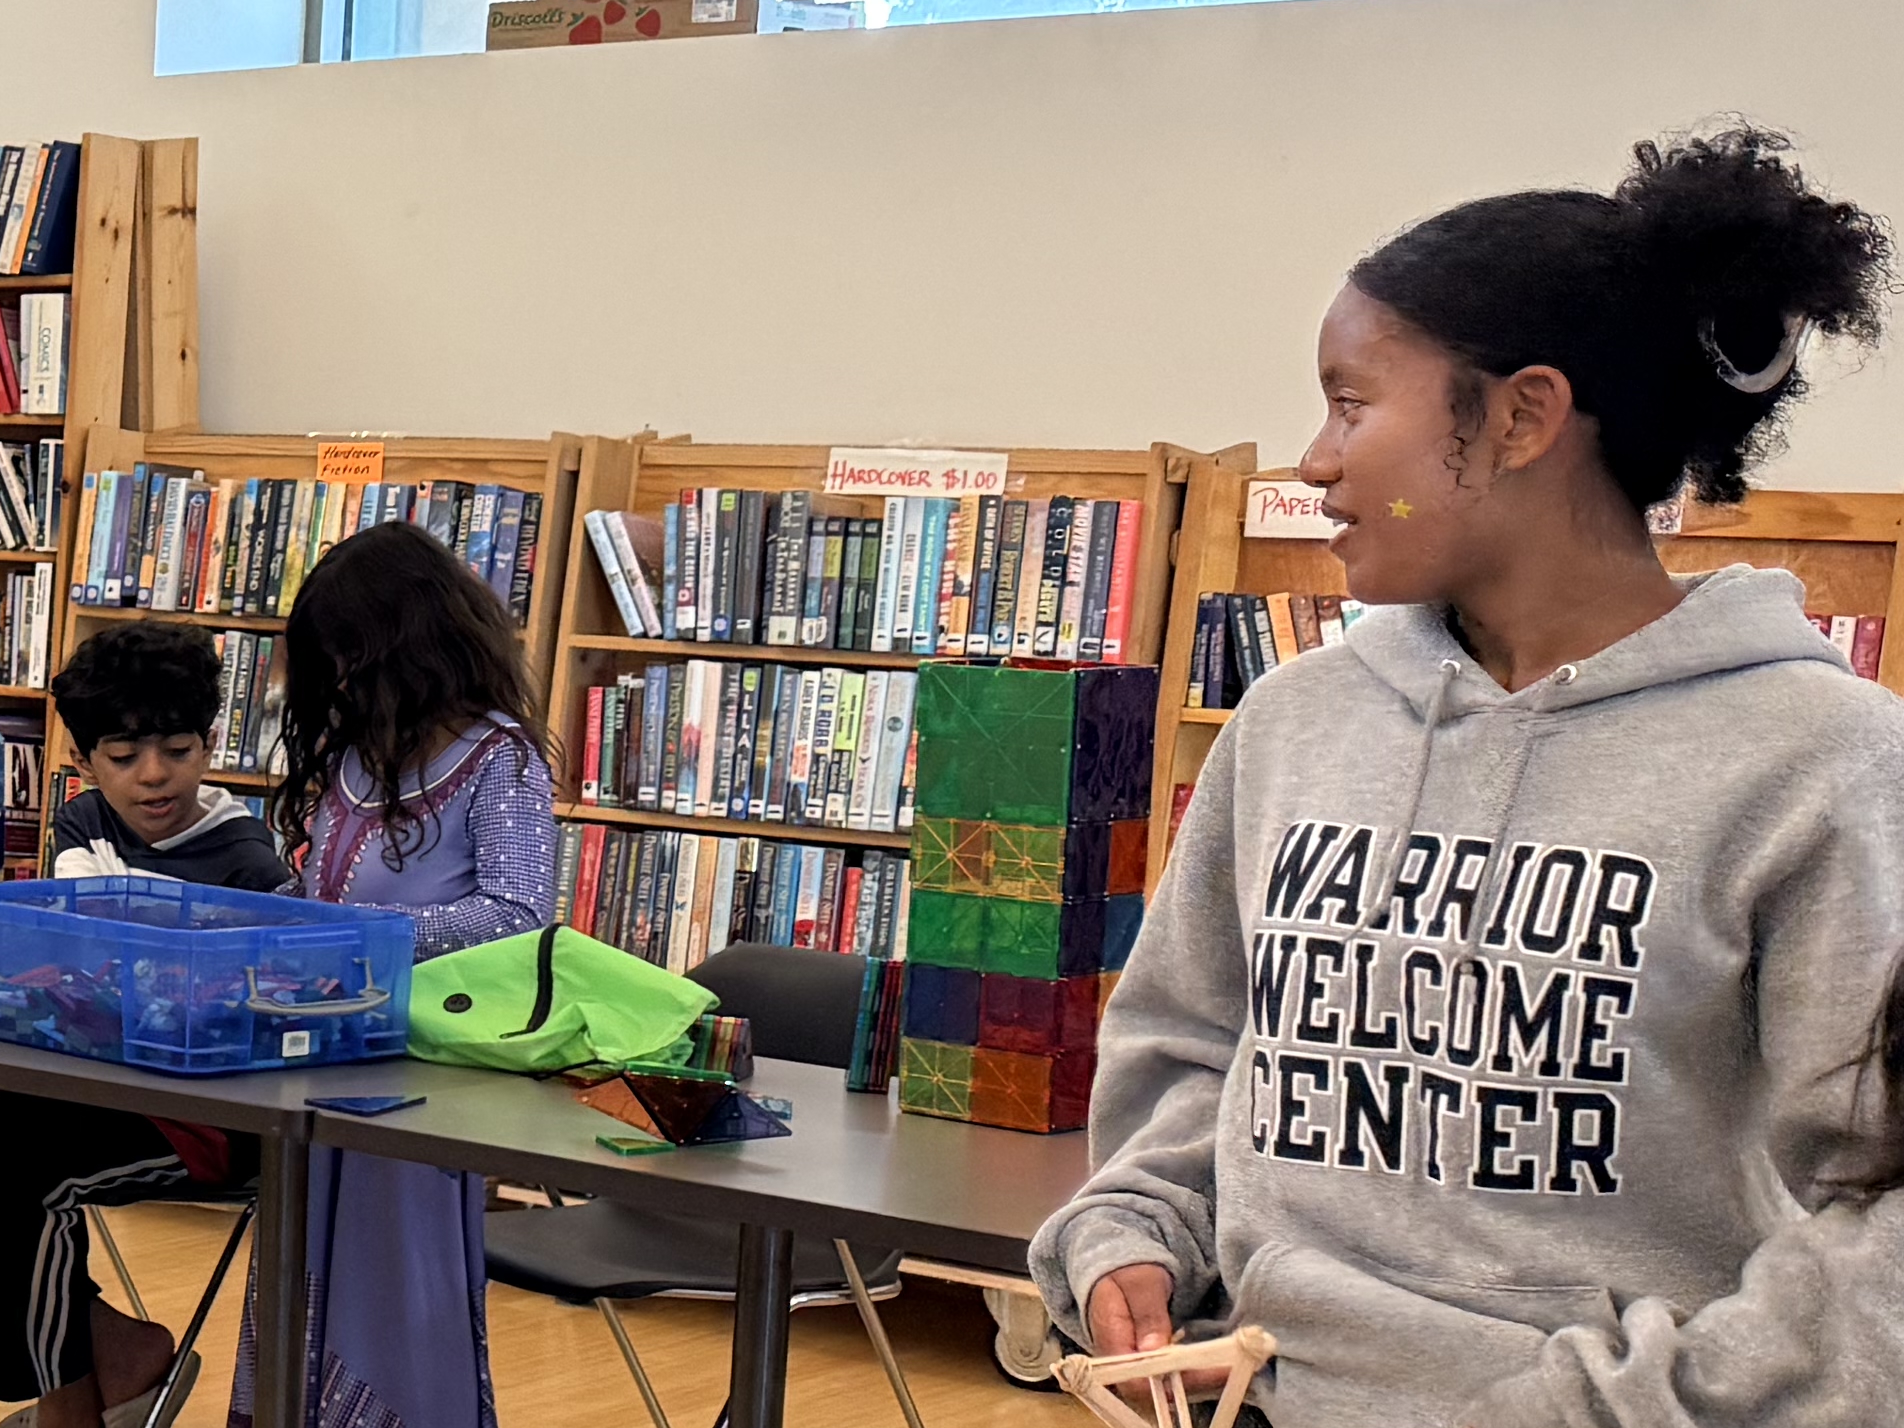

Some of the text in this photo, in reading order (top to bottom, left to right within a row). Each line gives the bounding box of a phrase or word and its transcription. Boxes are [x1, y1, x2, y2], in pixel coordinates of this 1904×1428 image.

[323, 446, 380, 459] Hardcover
[830, 460, 998, 491] HARDCOVER $1.00
[1263, 817, 1658, 972] WARRIOR
[1251, 931, 1638, 1086] WELCOME
[1251, 1046, 1622, 1197] CENTER
